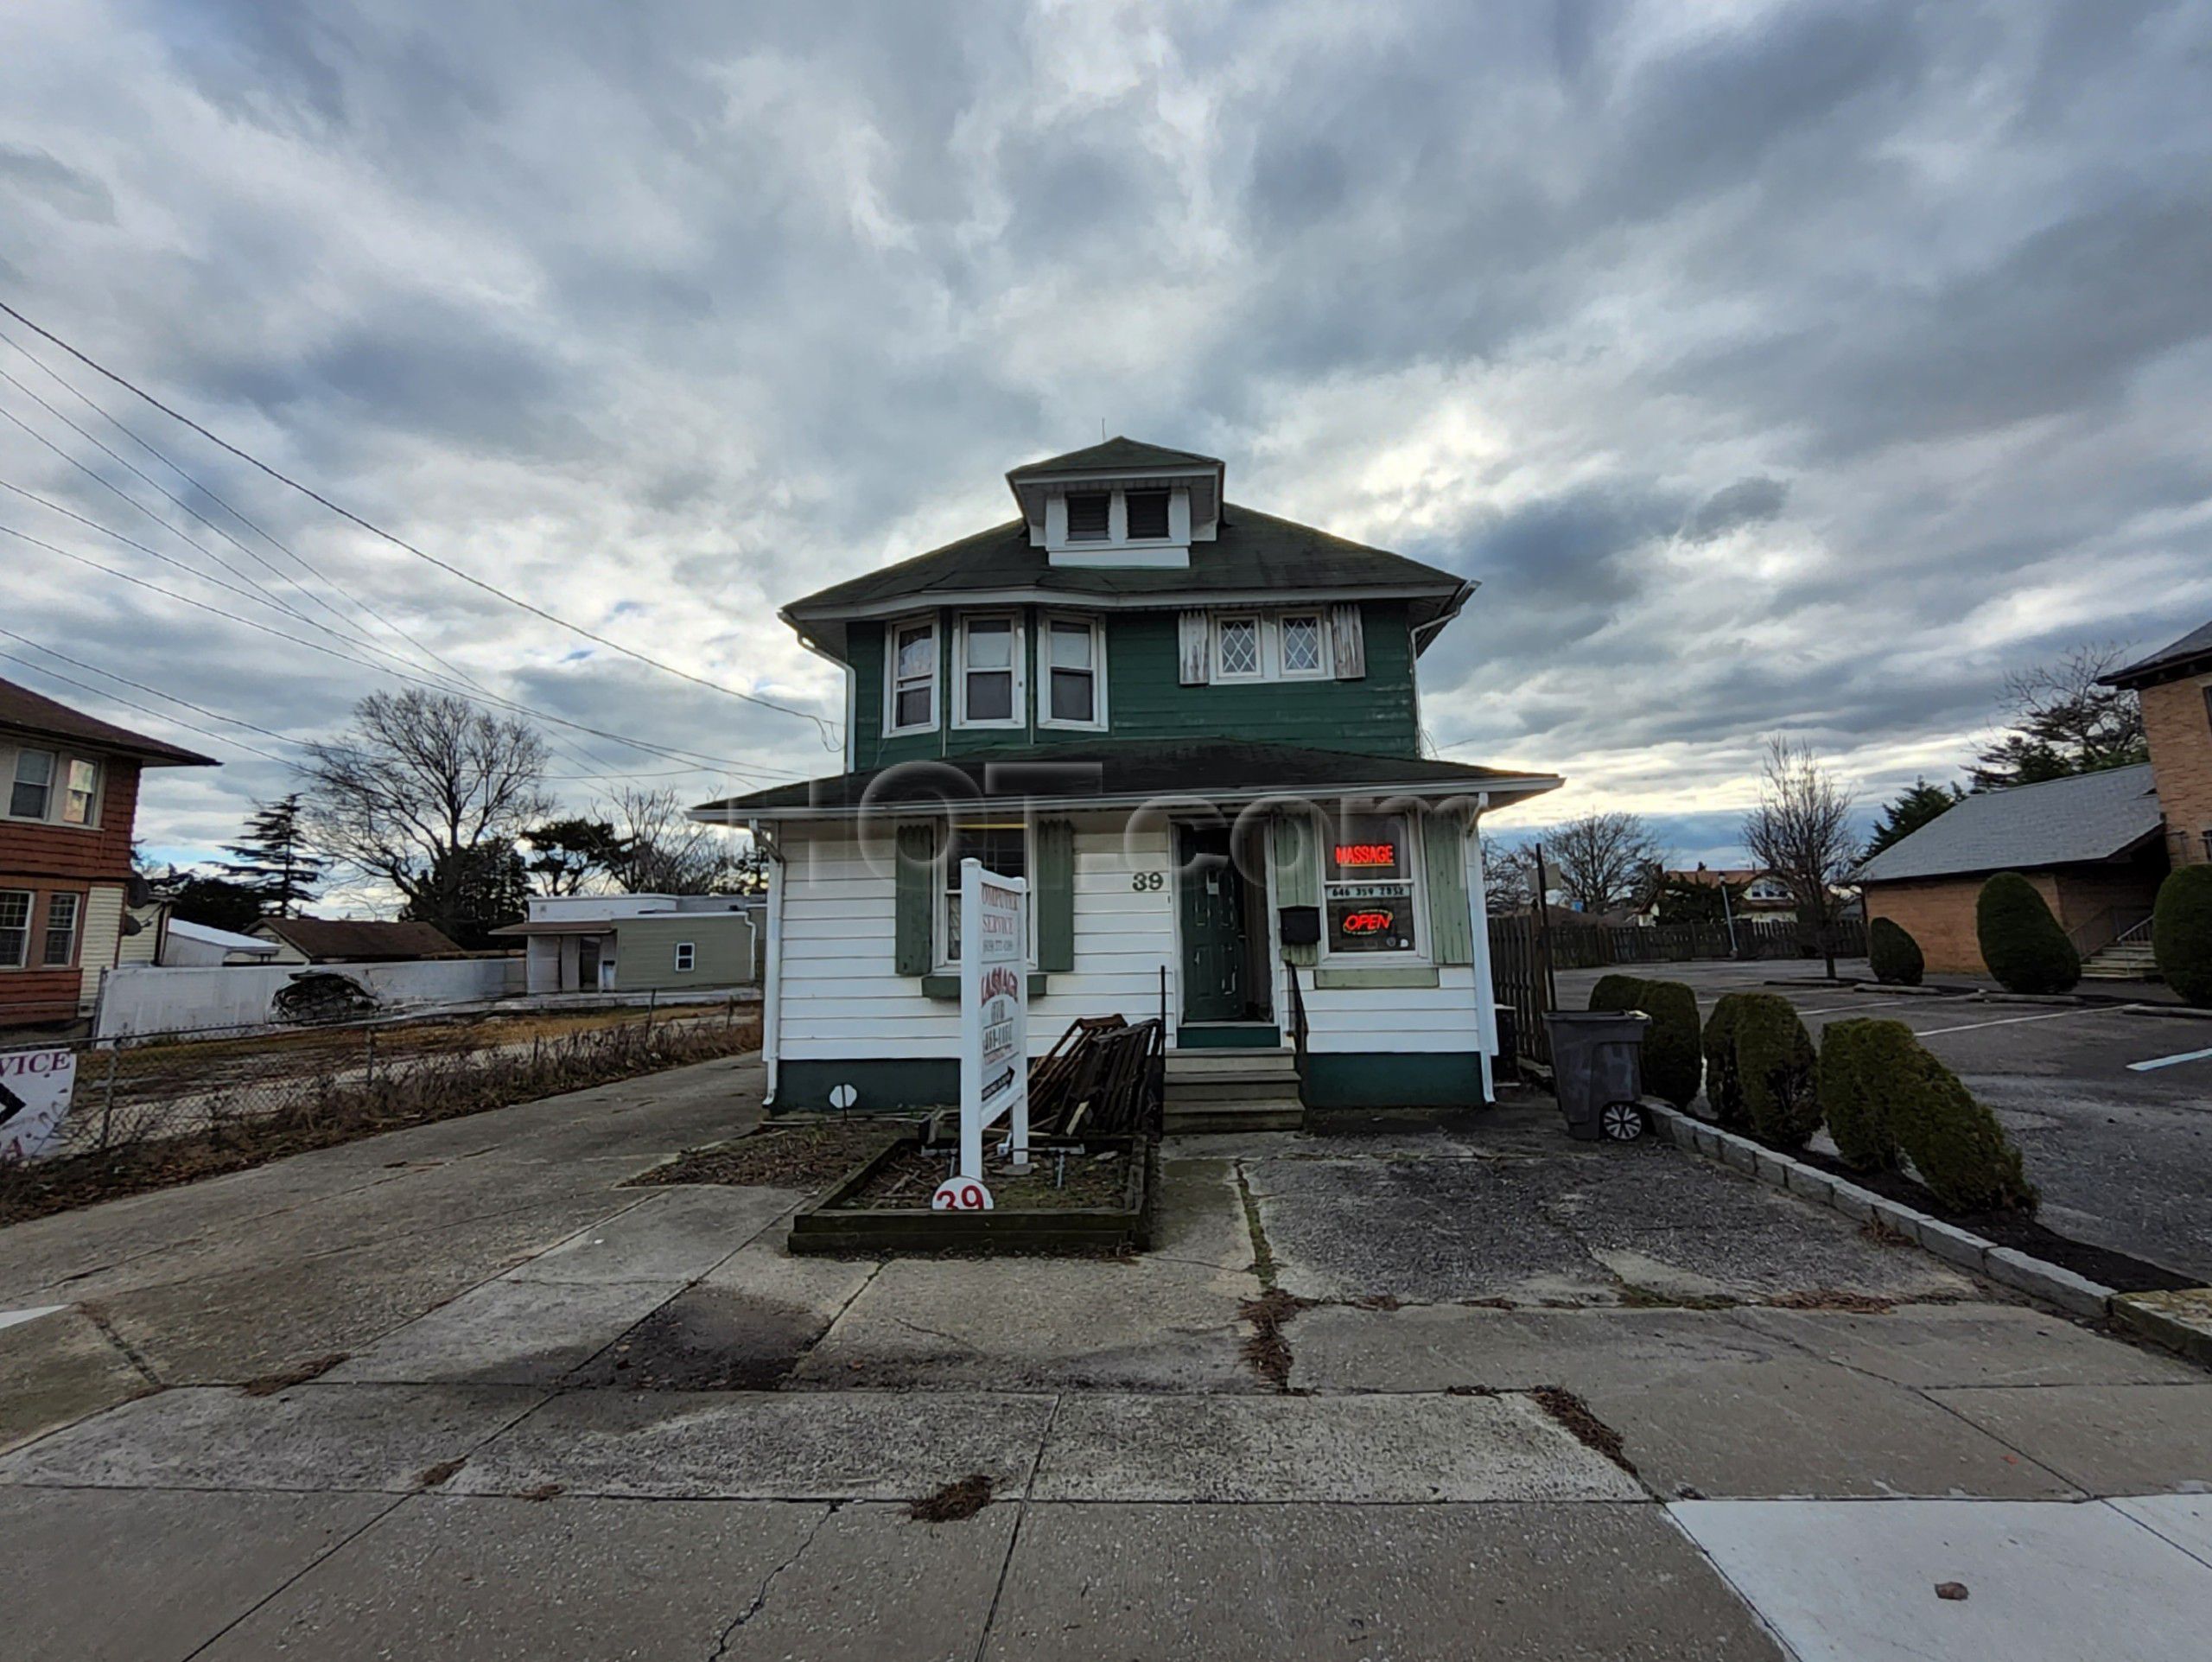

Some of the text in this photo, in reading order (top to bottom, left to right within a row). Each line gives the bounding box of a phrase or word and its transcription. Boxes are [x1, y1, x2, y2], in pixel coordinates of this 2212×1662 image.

[1336, 845, 1394, 864] MASSAGE
[1132, 872, 1164, 891] 39
[982, 885, 1018, 910] OMPUTER
[1345, 914, 1390, 931] OPEN
